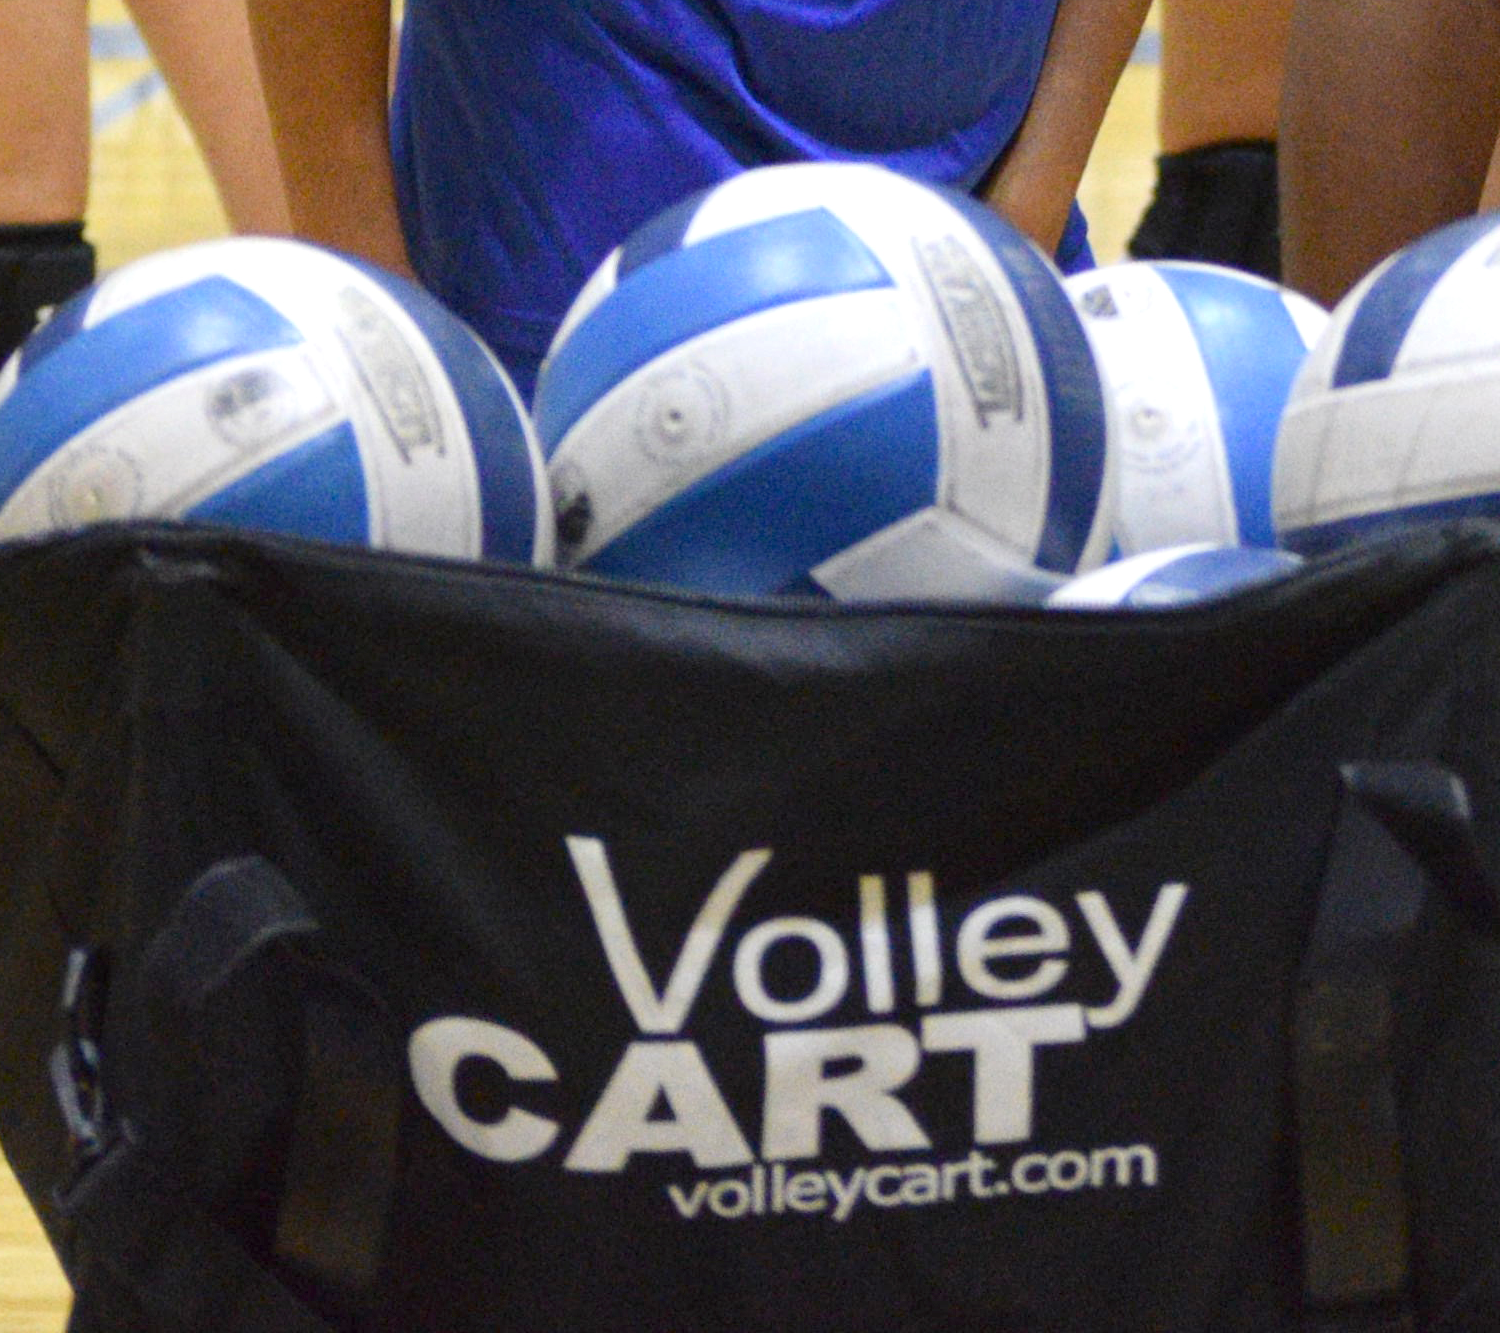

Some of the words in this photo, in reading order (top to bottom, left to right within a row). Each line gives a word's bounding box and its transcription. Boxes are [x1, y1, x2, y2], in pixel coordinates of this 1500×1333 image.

[565, 834, 1190, 1029] Volley
[407, 1003, 1087, 1174] CART
[668, 1142, 1159, 1222] volleycart.com
